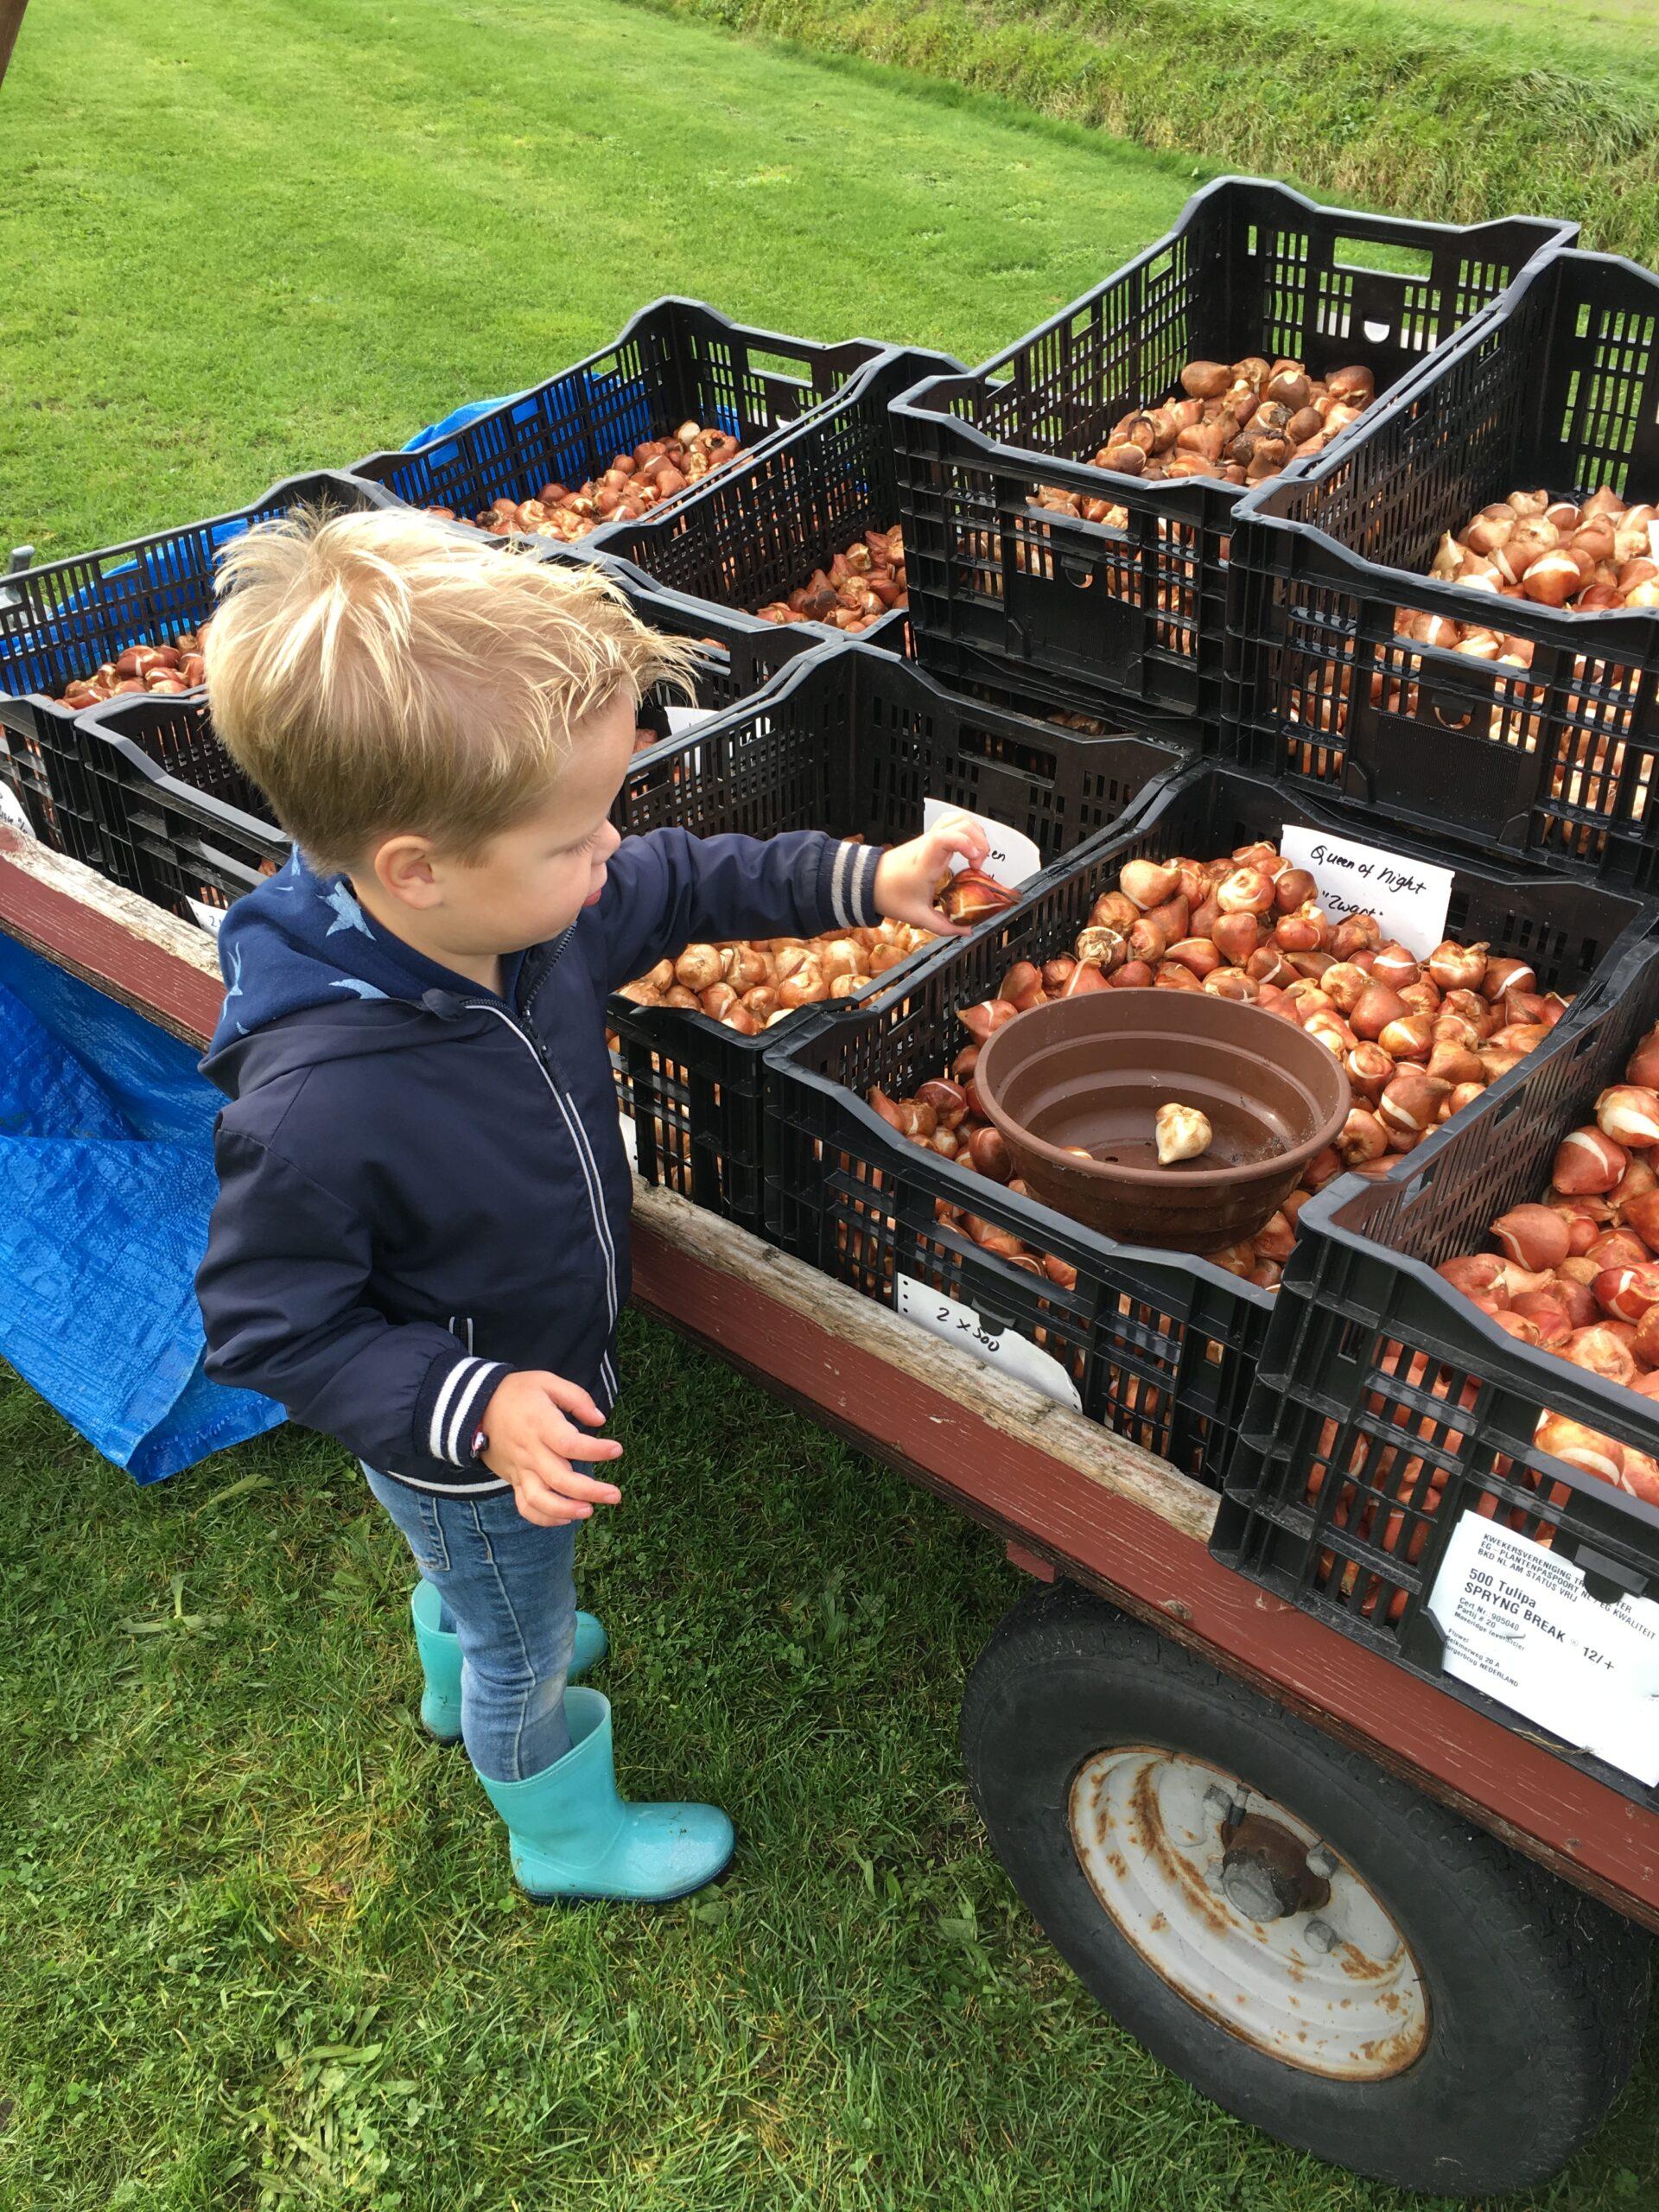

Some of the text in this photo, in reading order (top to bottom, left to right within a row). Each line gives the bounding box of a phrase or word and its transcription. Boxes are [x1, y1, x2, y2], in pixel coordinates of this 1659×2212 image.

[1311, 845, 1355, 869] Queen
[1358, 864, 1375, 878] of
[937, 1307, 950, 1322] 2
[1478, 1548, 1578, 1602] BKD NL AM STATUS VRIJ
[1484, 1534, 1572, 1580] KWEKERSVERENIGING
[1469, 1568, 1536, 1608] 500 Tulipa
[1481, 1541, 1491, 1550] EG
[1499, 1549, 1579, 1593] PLANTENPASPOORT
[1612, 1609, 1656, 1640] KWALITEIT
[1457, 1605, 1477, 1619] Partij
[1486, 1619, 1496, 1628] 20
[1465, 1582, 1520, 1615] SPRYNG
[1523, 1609, 1566, 1643] BREAK
[1479, 1662, 1518, 1687] NEDERLAND
